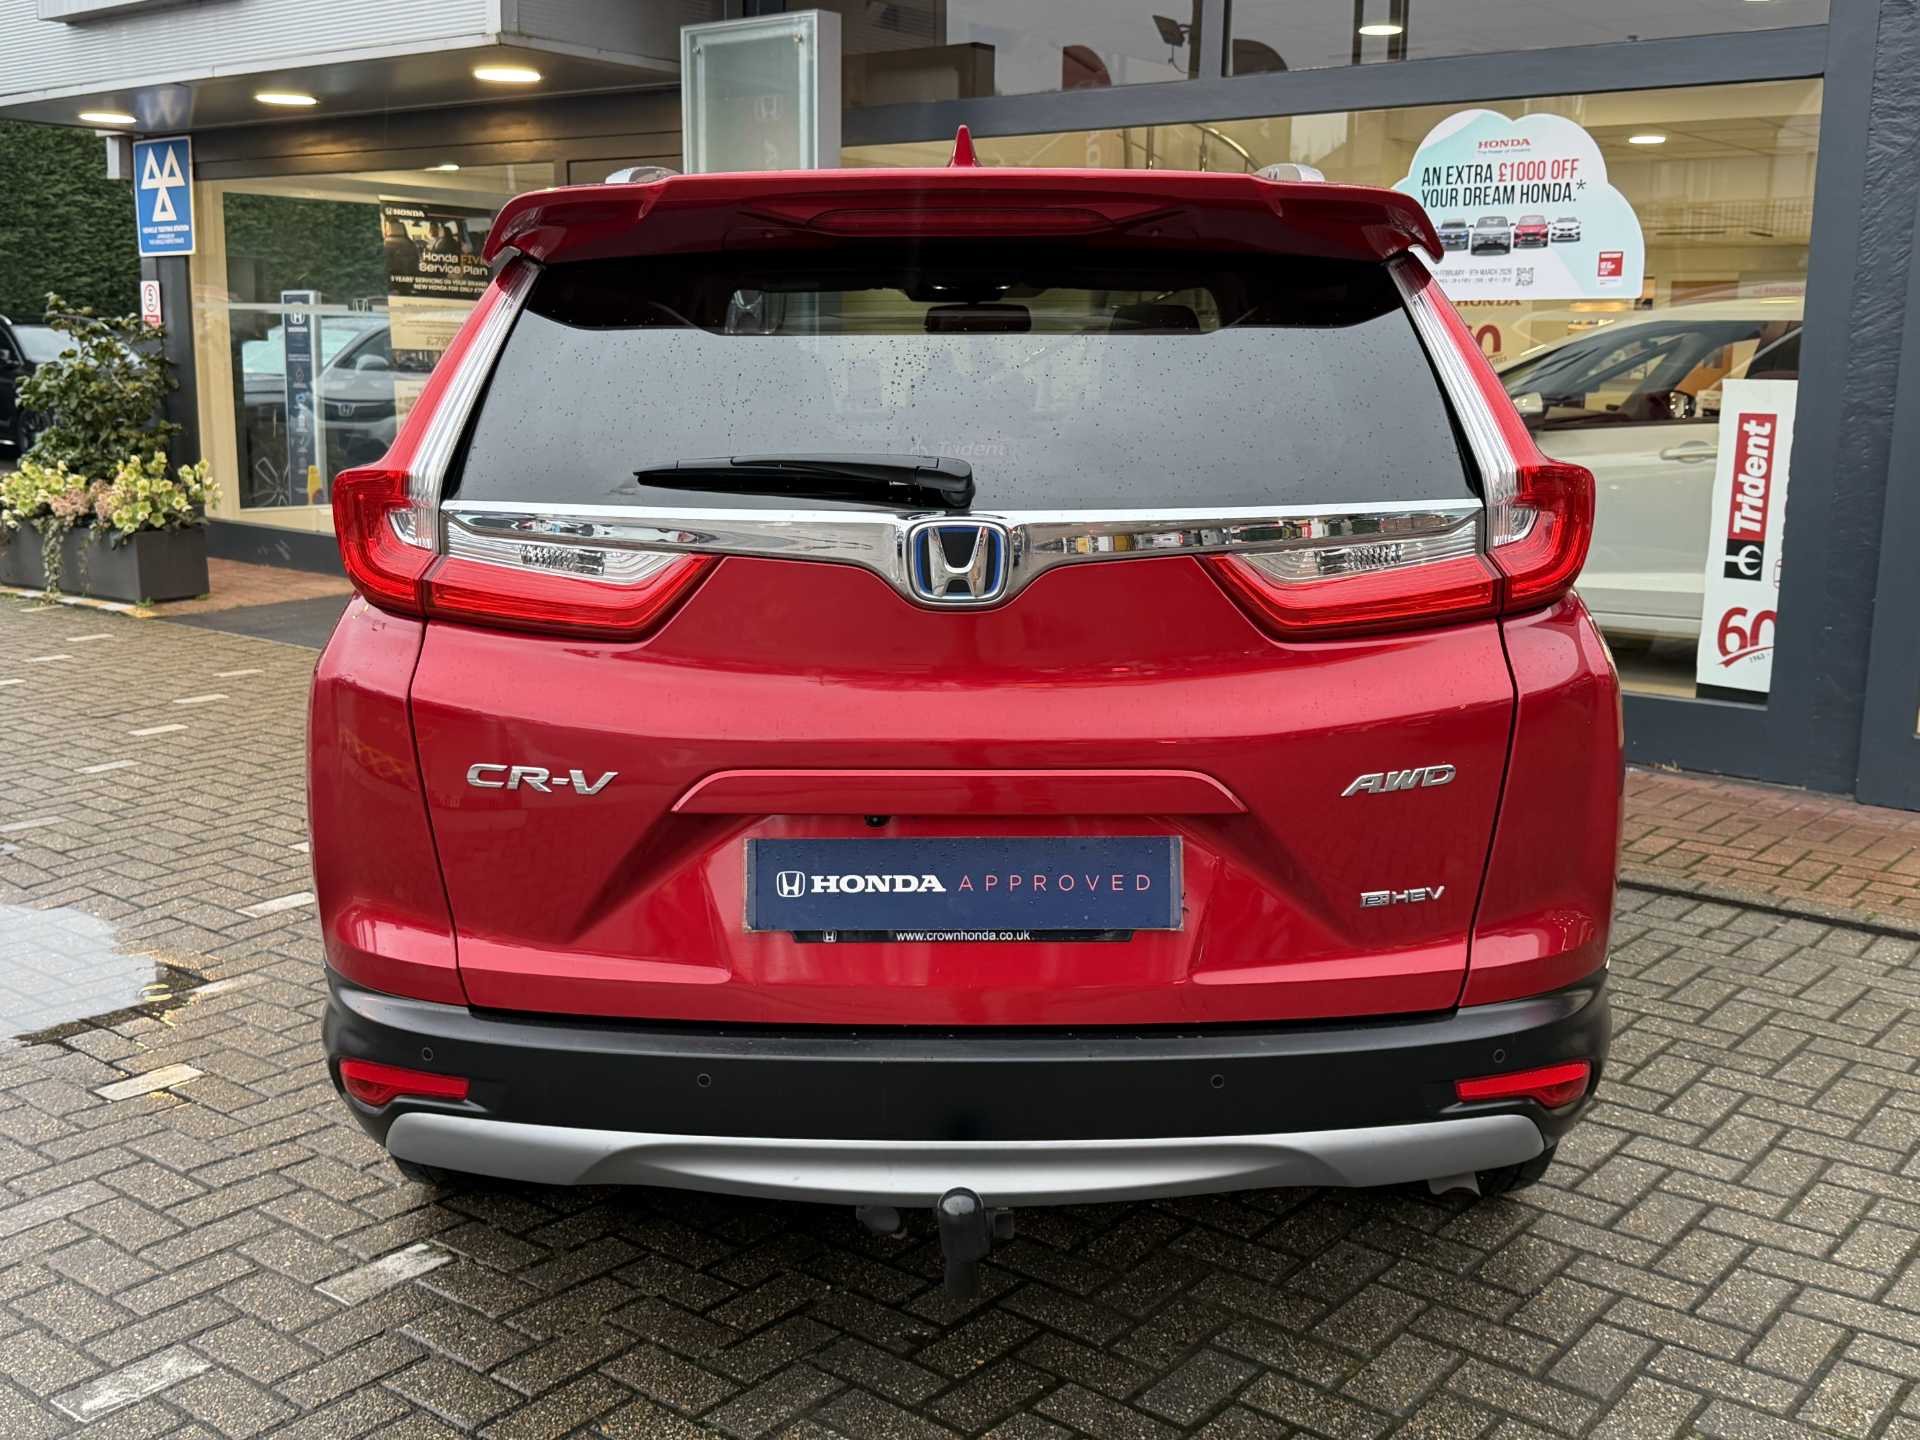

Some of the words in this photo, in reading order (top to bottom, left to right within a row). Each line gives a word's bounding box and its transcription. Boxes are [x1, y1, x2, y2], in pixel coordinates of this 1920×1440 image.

[1478, 138, 1531, 149] HONDA
[1421, 166, 1442, 187] AN
[1446, 163, 1494, 186] EXTRA
[1497, 160, 1546, 183] £1000
[1551, 158, 1580, 180] OFF
[1422, 187, 1458, 208] YOUR
[1463, 184, 1515, 207] DREAM
[393, 207, 425, 218] HONDA
[422, 251, 459, 263] Honda
[419, 262, 461, 274] Service
[463, 264, 488, 276] Plan
[1733, 419, 1772, 535] Trident
[466, 763, 619, 795] CR-V
[1340, 764, 1457, 797] AWD
[810, 875, 947, 893] HONDA
[958, 874, 1151, 892] APPROVED
[896, 930, 1032, 942] www.crownhonda.co.uk
